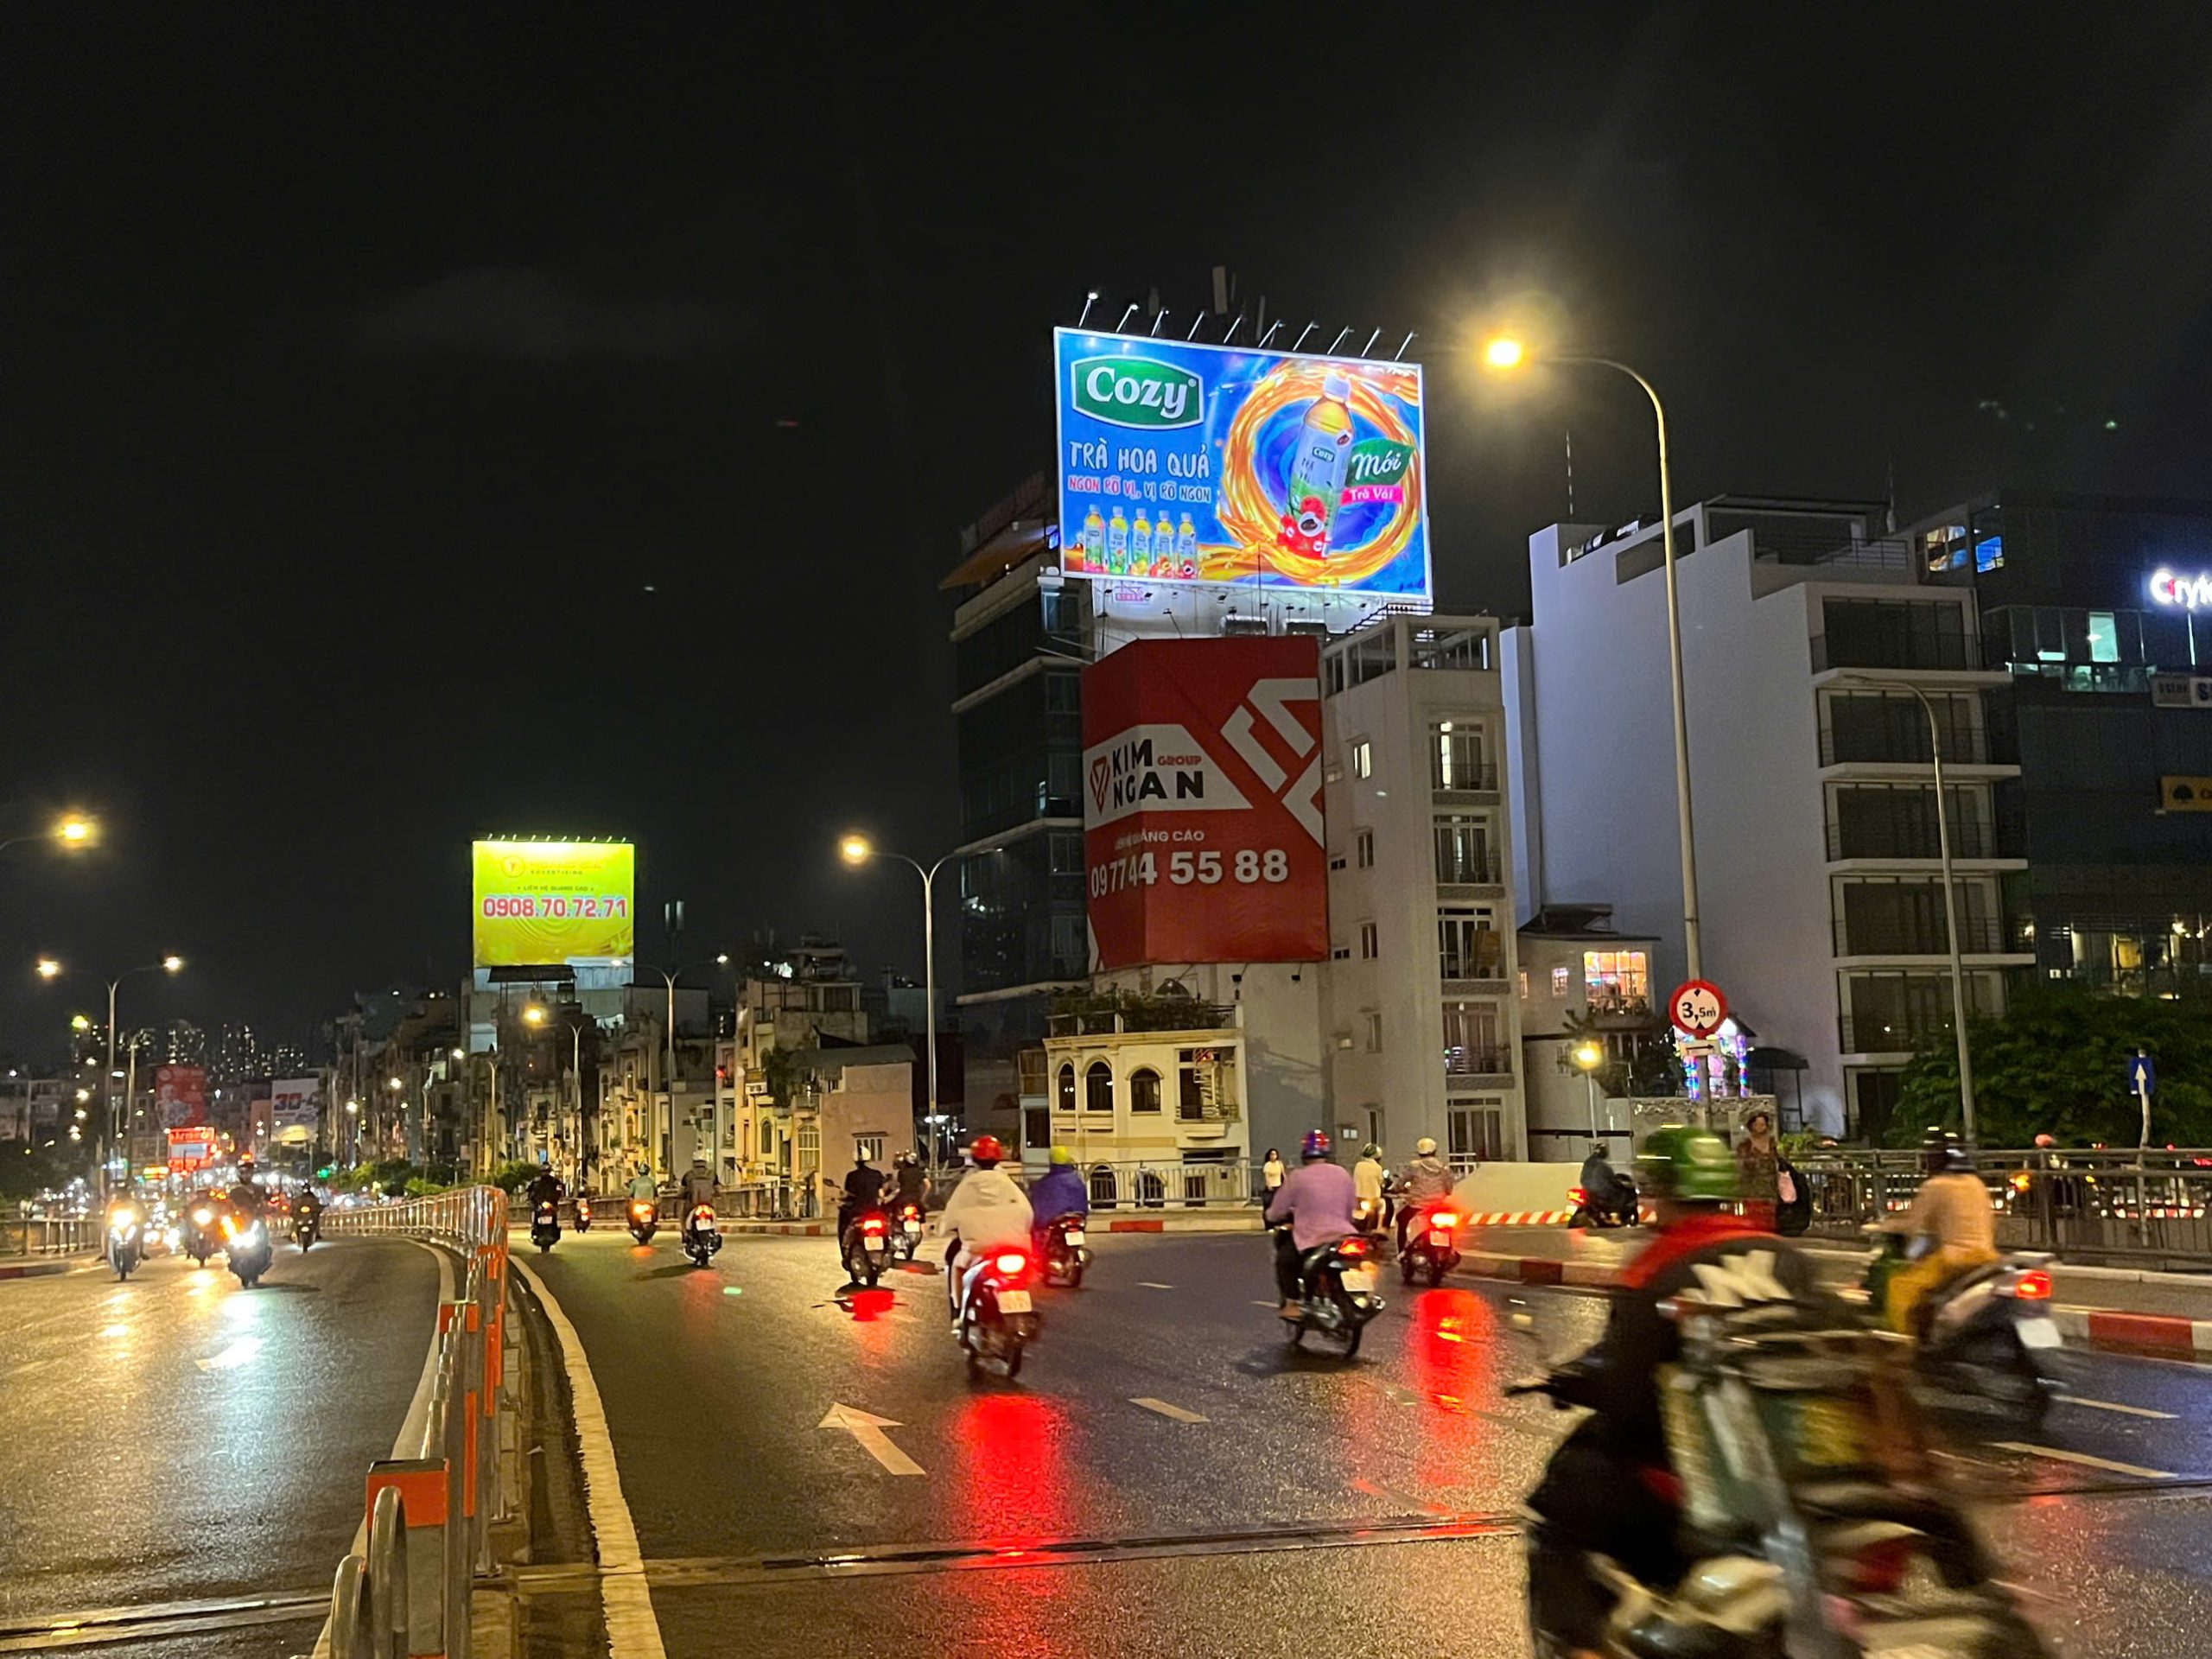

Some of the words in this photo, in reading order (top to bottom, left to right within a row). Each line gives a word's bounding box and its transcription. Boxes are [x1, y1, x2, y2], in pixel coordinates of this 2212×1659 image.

[1086, 366, 1188, 419] Cozy
[1069, 437, 1109, 470] TRÀ
[1117, 448, 1158, 474] HOA
[1166, 443, 1210, 479] QUẢ
[1351, 449, 1402, 480] Mới
[1069, 476, 1100, 493] NGON
[1104, 475, 1121, 494] RÕ
[1144, 480, 1157, 501] VỊ
[1160, 480, 1177, 499] RÕ
[1180, 485, 1211, 503] NGON
[1112, 738, 1153, 778] KIM
[1158, 755, 1203, 766] GROUP
[1114, 771, 1205, 810] NGAN
[1173, 829, 1205, 842] CÁO
[1170, 851, 1223, 885] 55
[1235, 849, 1288, 883] 88
[483, 896, 626, 918] 0908.70.72.71
[1681, 1001, 1717, 1022] 3,5m
